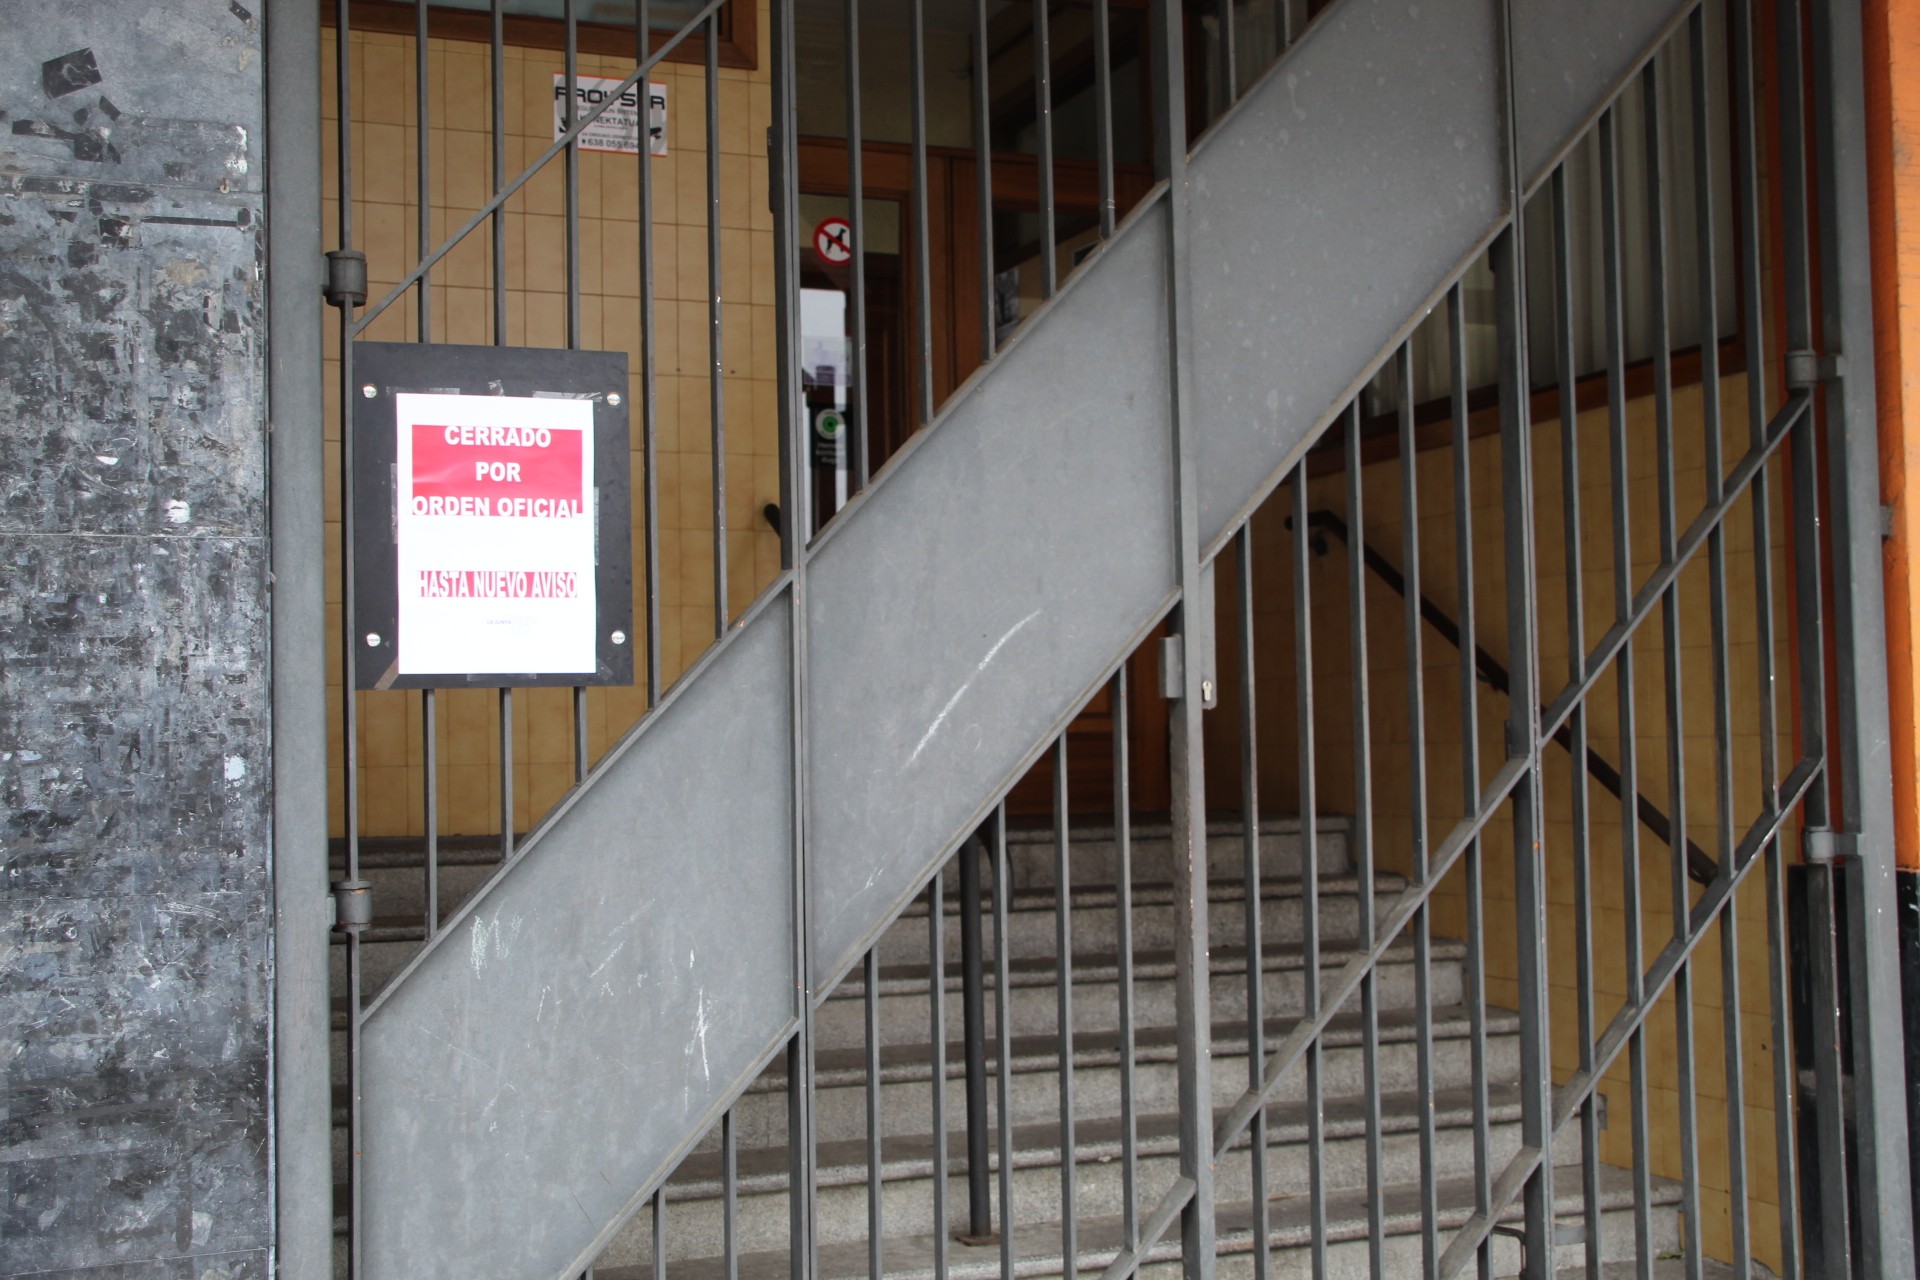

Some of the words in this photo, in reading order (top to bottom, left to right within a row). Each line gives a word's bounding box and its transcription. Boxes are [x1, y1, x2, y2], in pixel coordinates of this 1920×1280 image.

[444, 425, 552, 448] CERRADO
[475, 461, 521, 482] POR
[412, 495, 490, 516] ORDEN
[497, 497, 582, 518] OFICIAL
[420, 571, 469, 598] HASTA
[473, 571, 527, 598] NUEVO
[532, 571, 578, 598] AVISO
